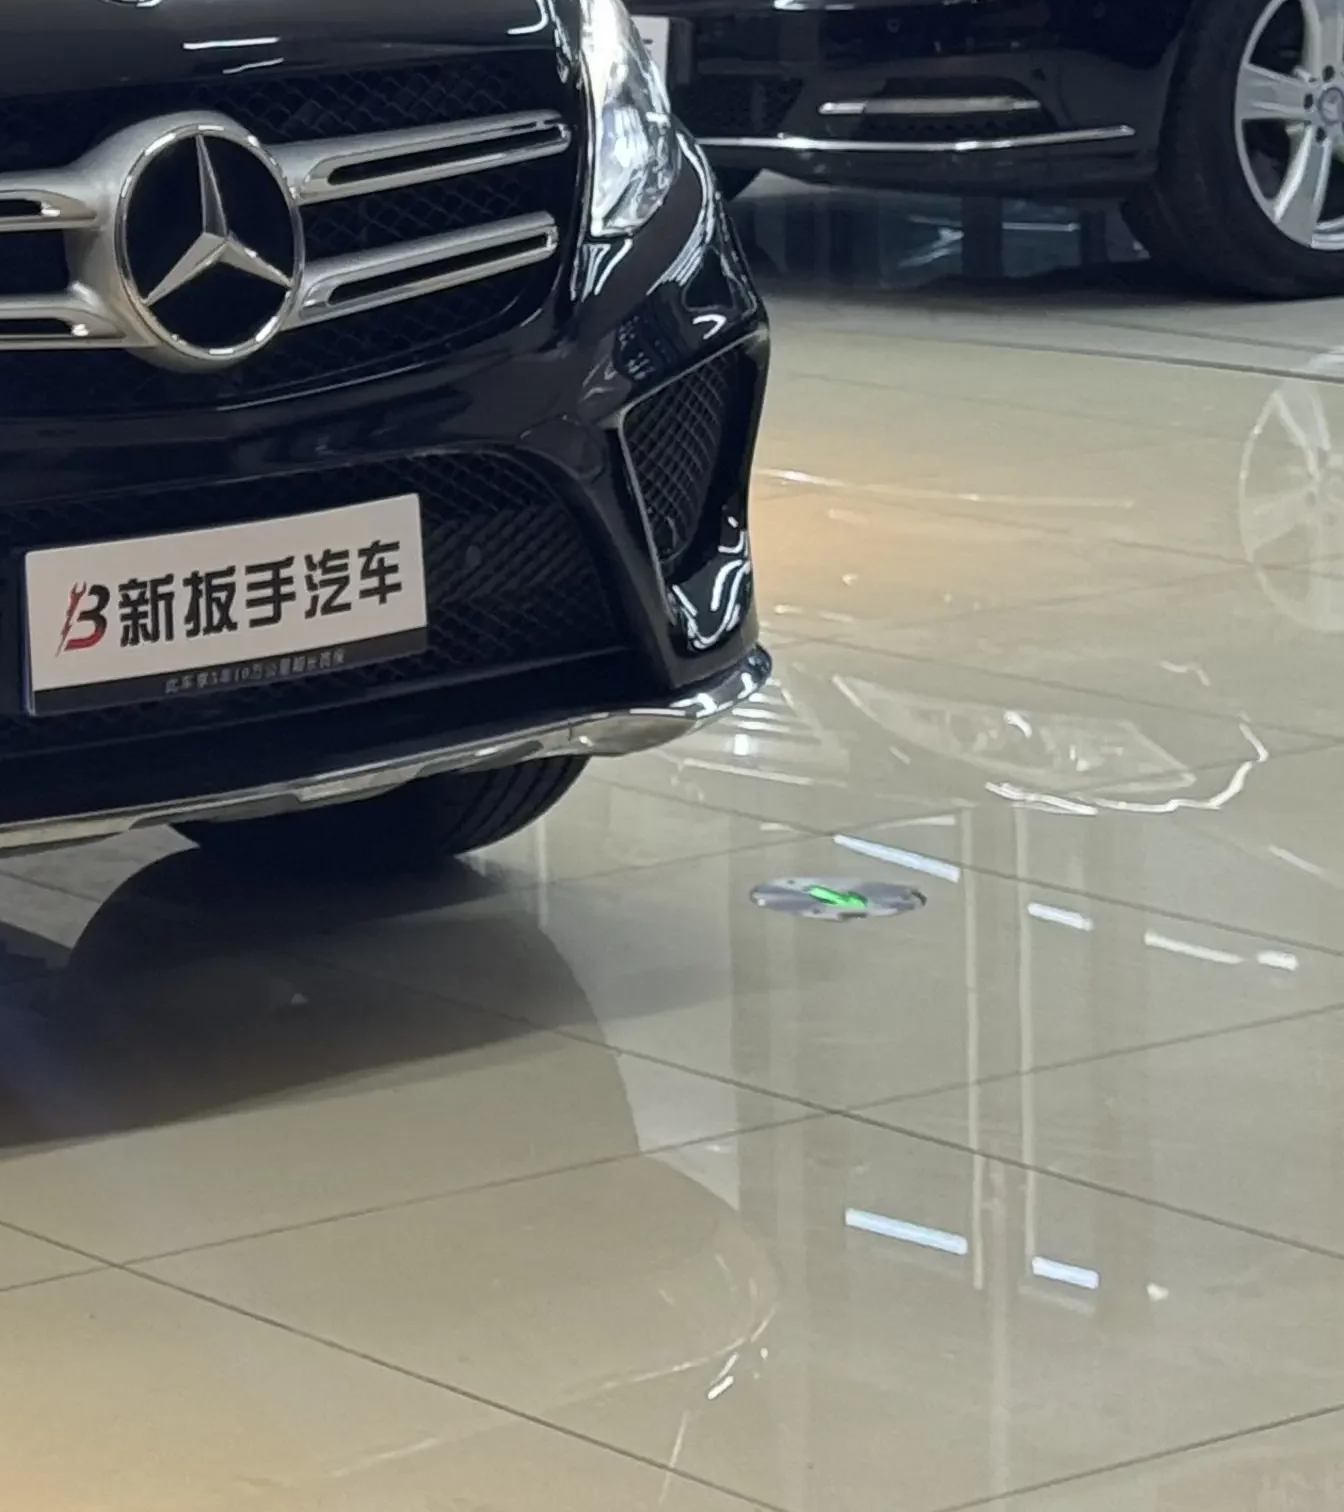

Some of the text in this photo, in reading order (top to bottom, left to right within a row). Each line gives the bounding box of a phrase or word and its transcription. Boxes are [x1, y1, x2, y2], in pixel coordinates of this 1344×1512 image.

[117, 539, 403, 648] 新扳手汽车
